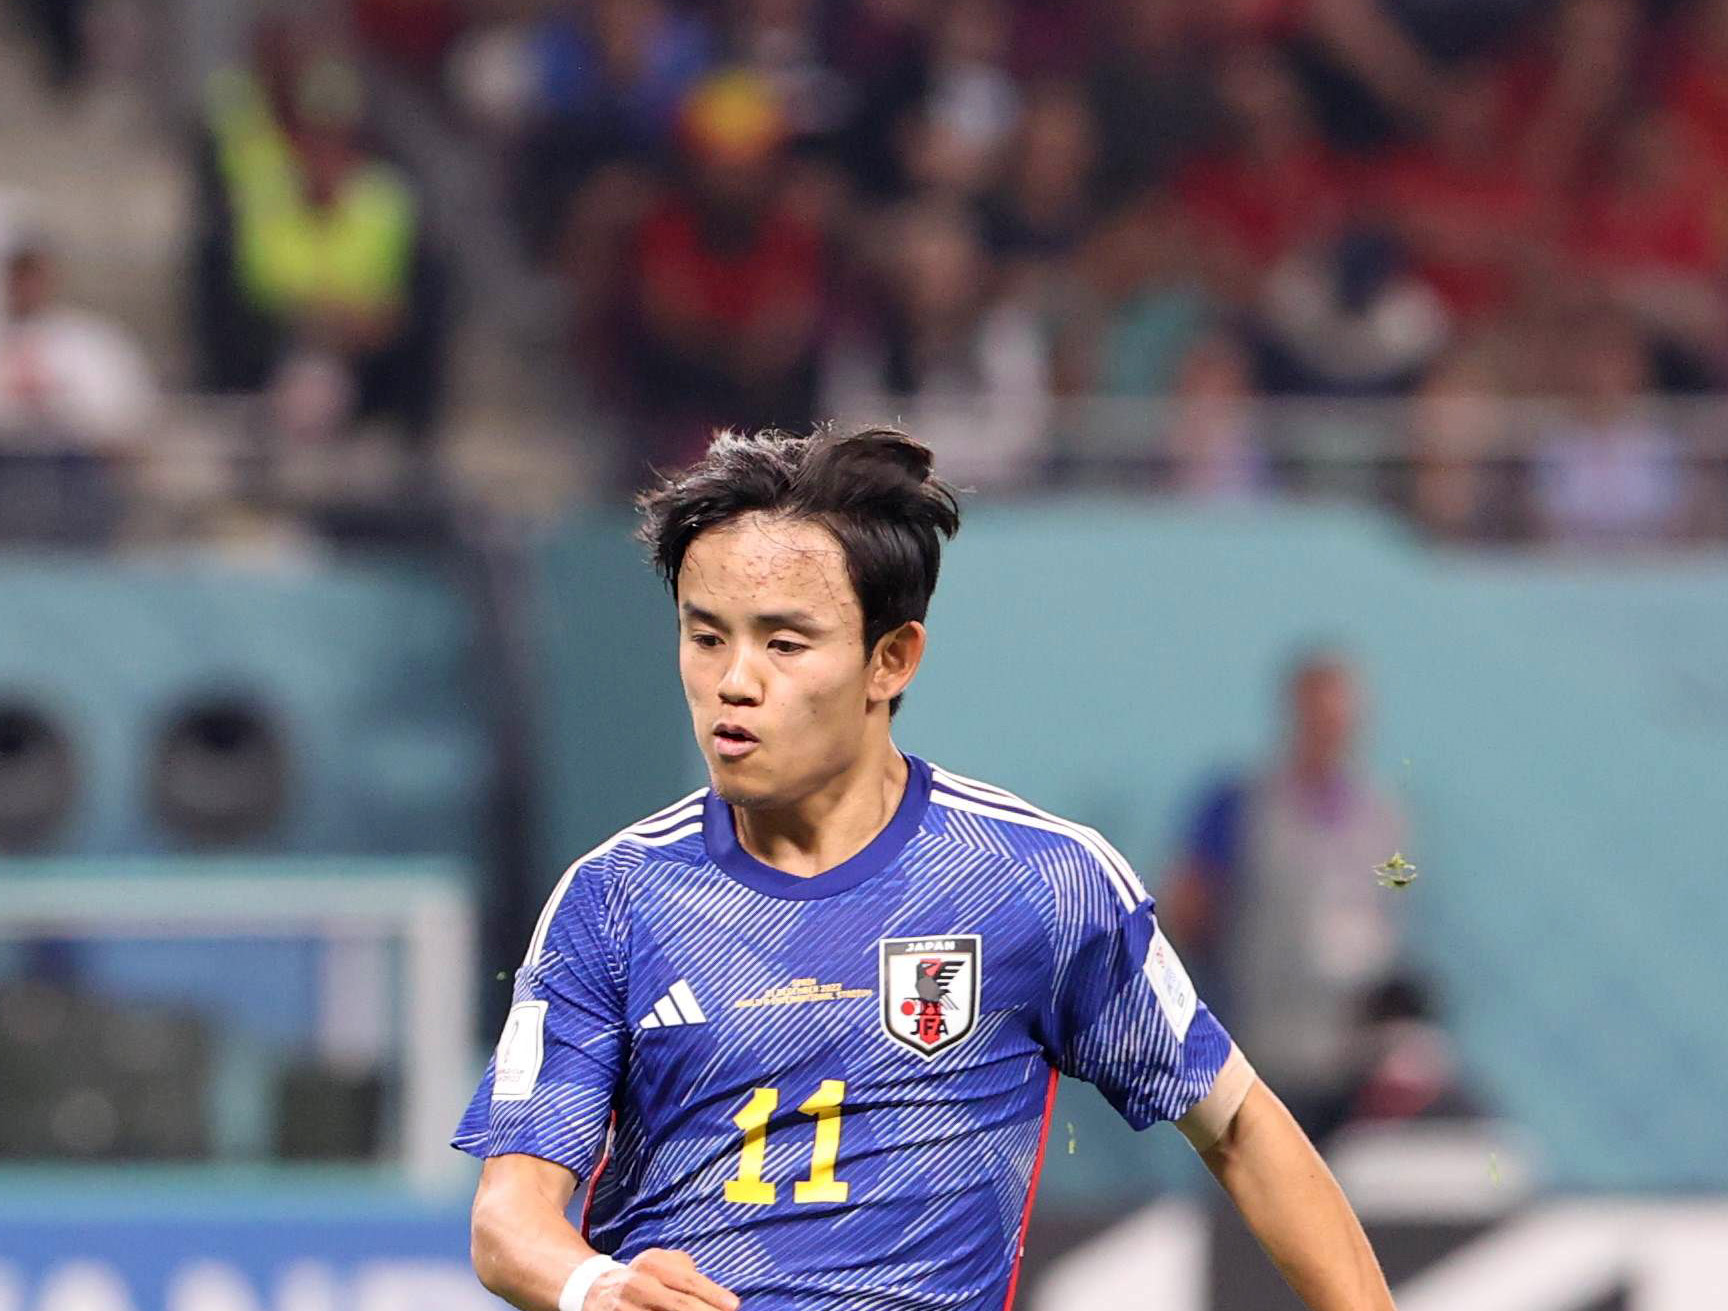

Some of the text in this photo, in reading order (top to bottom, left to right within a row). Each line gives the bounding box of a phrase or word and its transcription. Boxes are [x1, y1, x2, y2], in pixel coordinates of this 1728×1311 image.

[905, 940, 956, 953] JAPAN
[909, 1018, 949, 1036] JFA
[723, 1080, 849, 1205] 11
